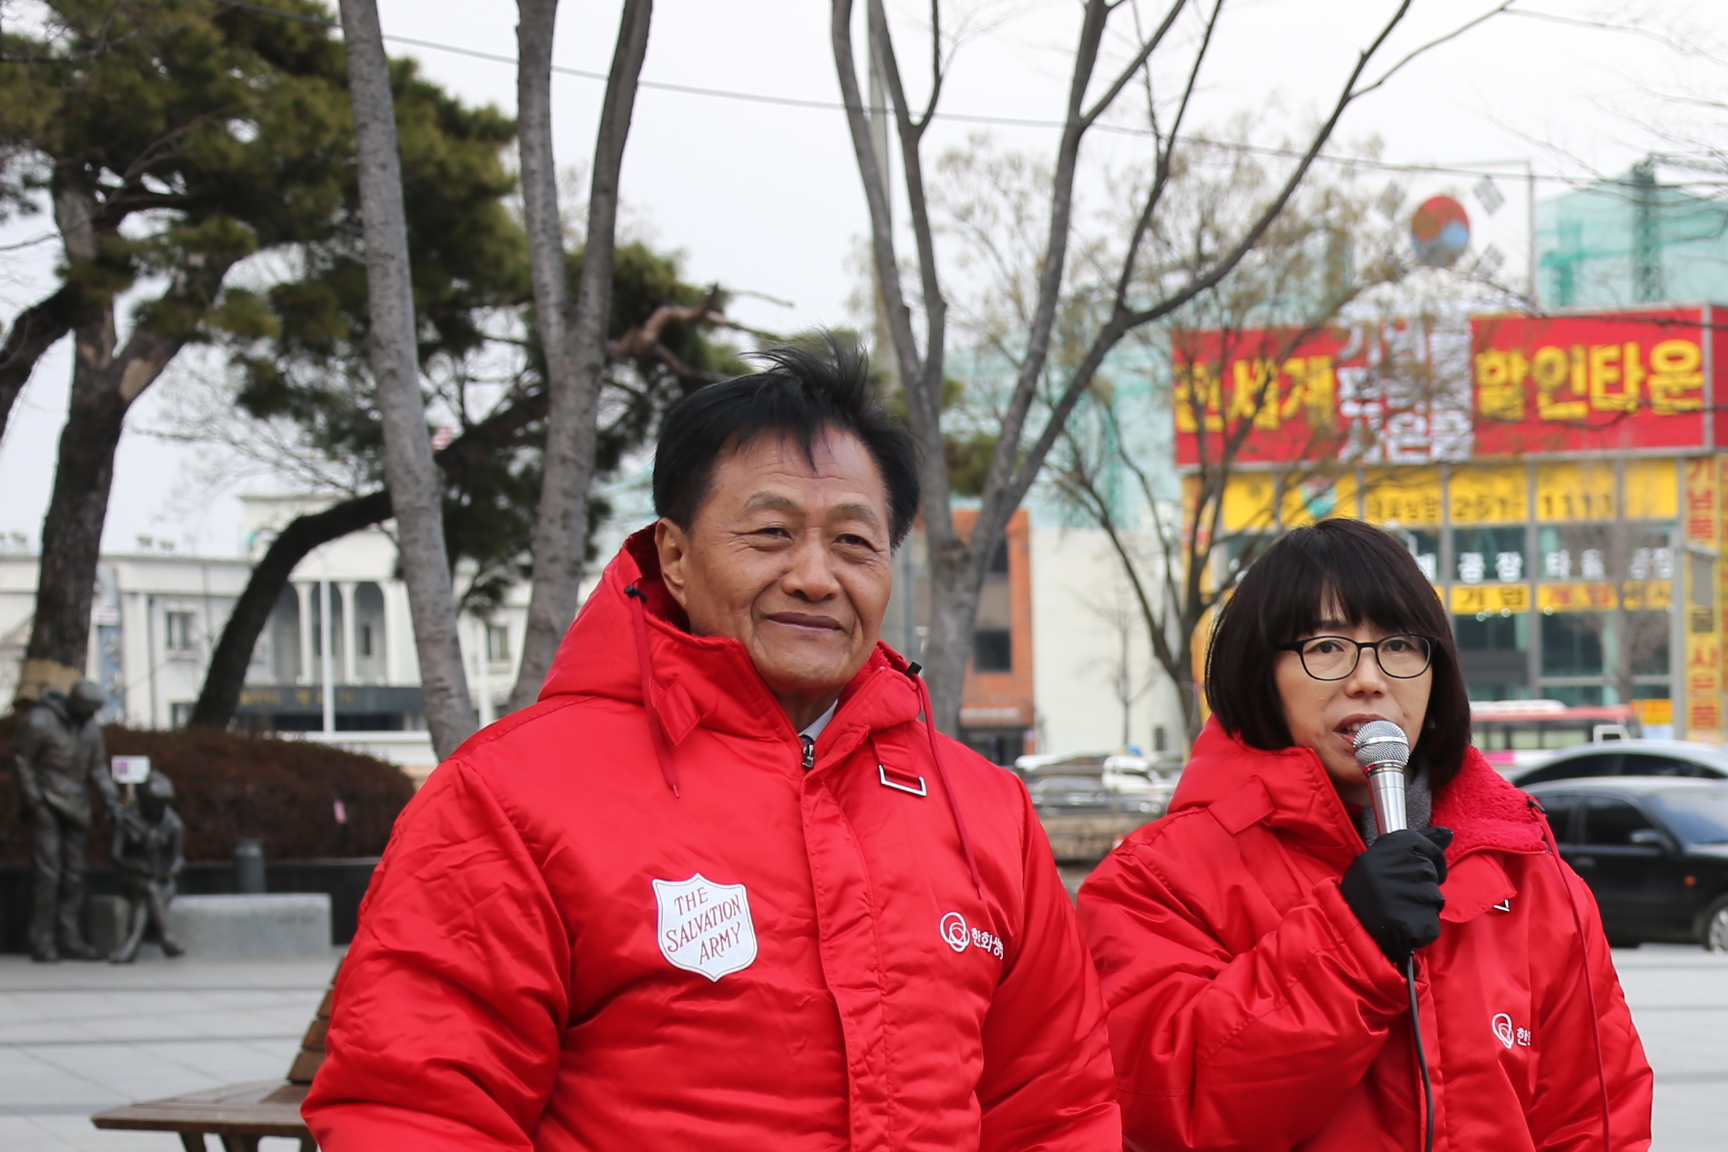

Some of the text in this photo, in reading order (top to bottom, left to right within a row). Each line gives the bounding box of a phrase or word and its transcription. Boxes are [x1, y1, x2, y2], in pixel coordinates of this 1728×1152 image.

[1475, 339, 1705, 421] 할인타운
[665, 893, 742, 953] SALVATION
[673, 886, 709, 917] THE
[699, 921, 741, 966] ARMY
[971, 927, 1004, 960] 한화생
